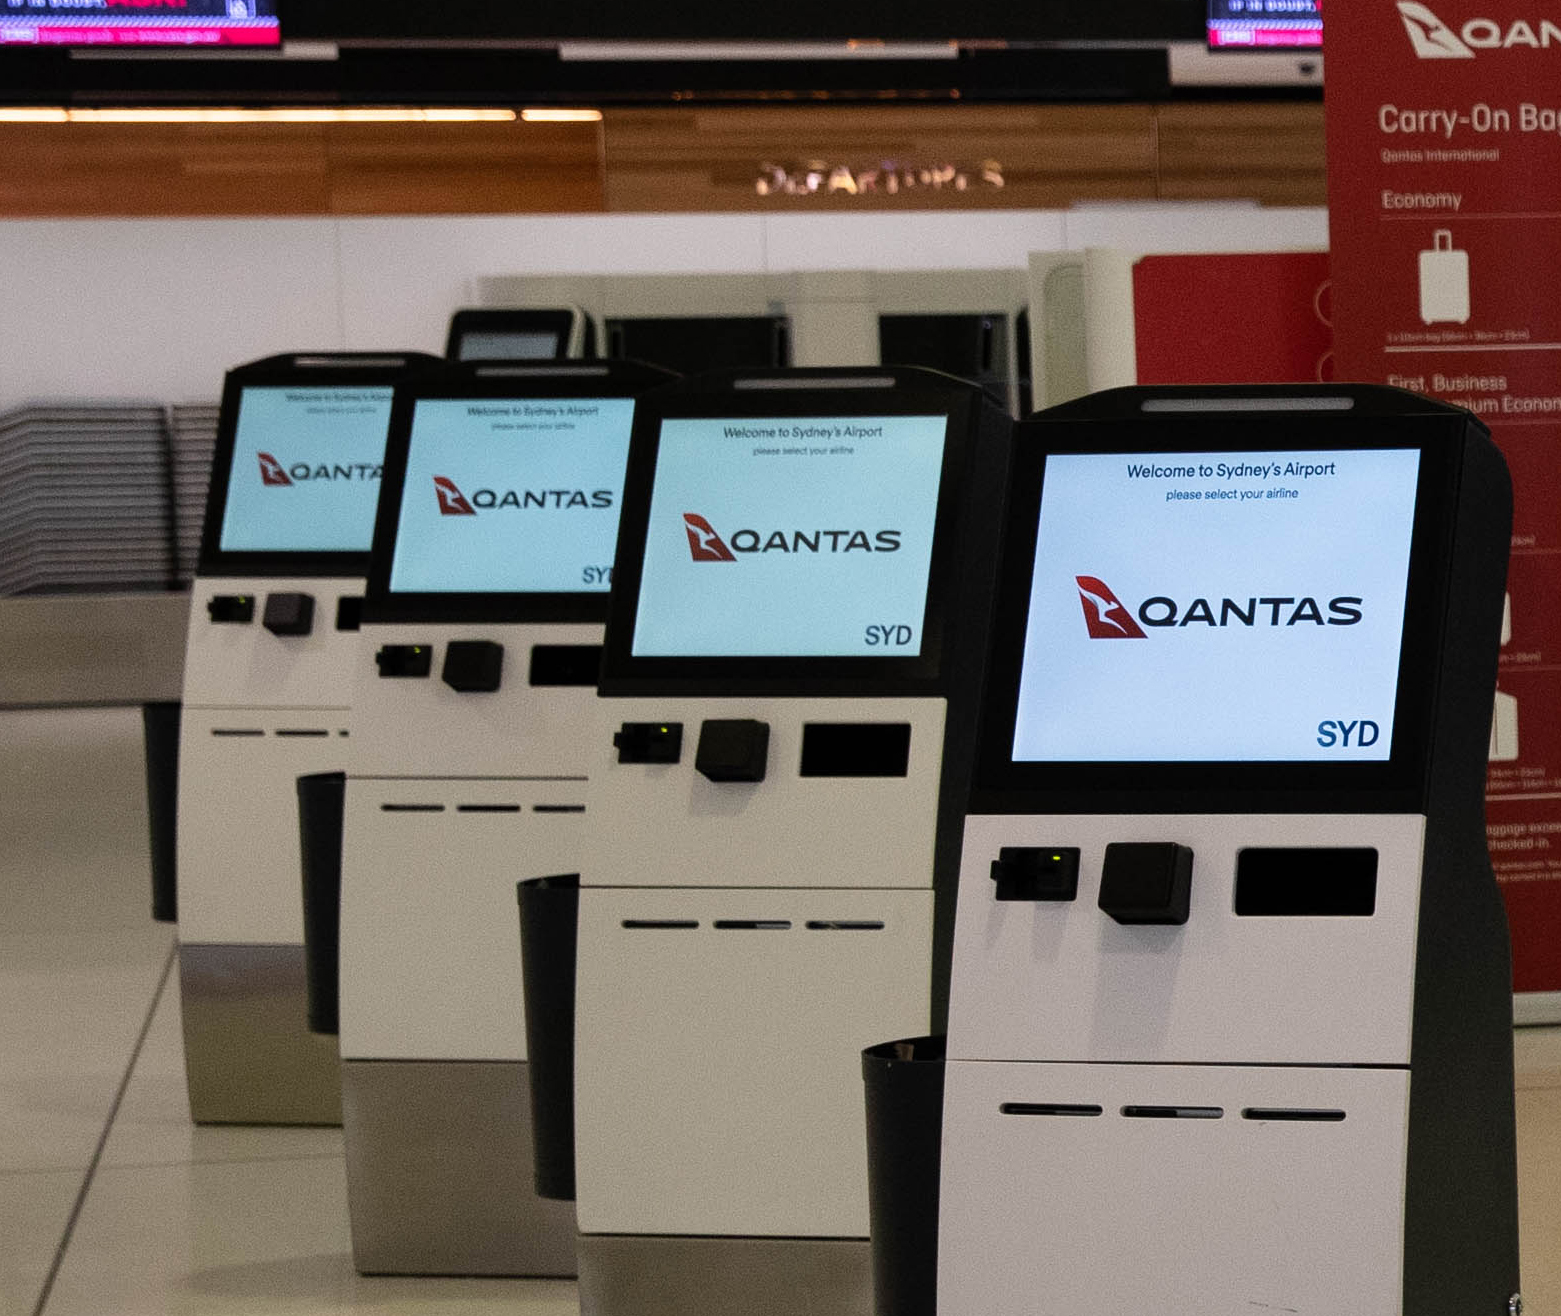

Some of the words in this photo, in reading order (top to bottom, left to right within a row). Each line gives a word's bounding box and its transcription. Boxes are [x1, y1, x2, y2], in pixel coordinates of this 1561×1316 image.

[1378, 103, 1510, 139] Carry-On
[1381, 148, 1424, 163] Qantas
[1426, 148, 1500, 162] International
[1381, 190, 1462, 211] Economy
[1432, 373, 1508, 392] Business
[1452, 398, 1499, 414] mium
[723, 426, 776, 439] Welcome
[779, 427, 790, 438] to
[792, 425, 842, 440] Sydney's
[843, 425, 883, 440] Airport
[809, 447, 828, 457] your
[1126, 463, 1195, 478] Welcome
[1199, 464, 1213, 477] to
[1216, 461, 1281, 480] Sydney's
[1284, 461, 1336, 479] Airport
[472, 489, 613, 509] QANTAS
[1166, 488, 1201, 501] please
[1204, 487, 1238, 500] select
[1240, 490, 1264, 501] your
[1266, 486, 1299, 499] airline
[730, 529, 902, 554] QANTAS
[582, 566, 613, 584] SY
[1138, 596, 1364, 628] QANTAS
[864, 624, 913, 646] SYD
[1316, 719, 1380, 748] SYD
